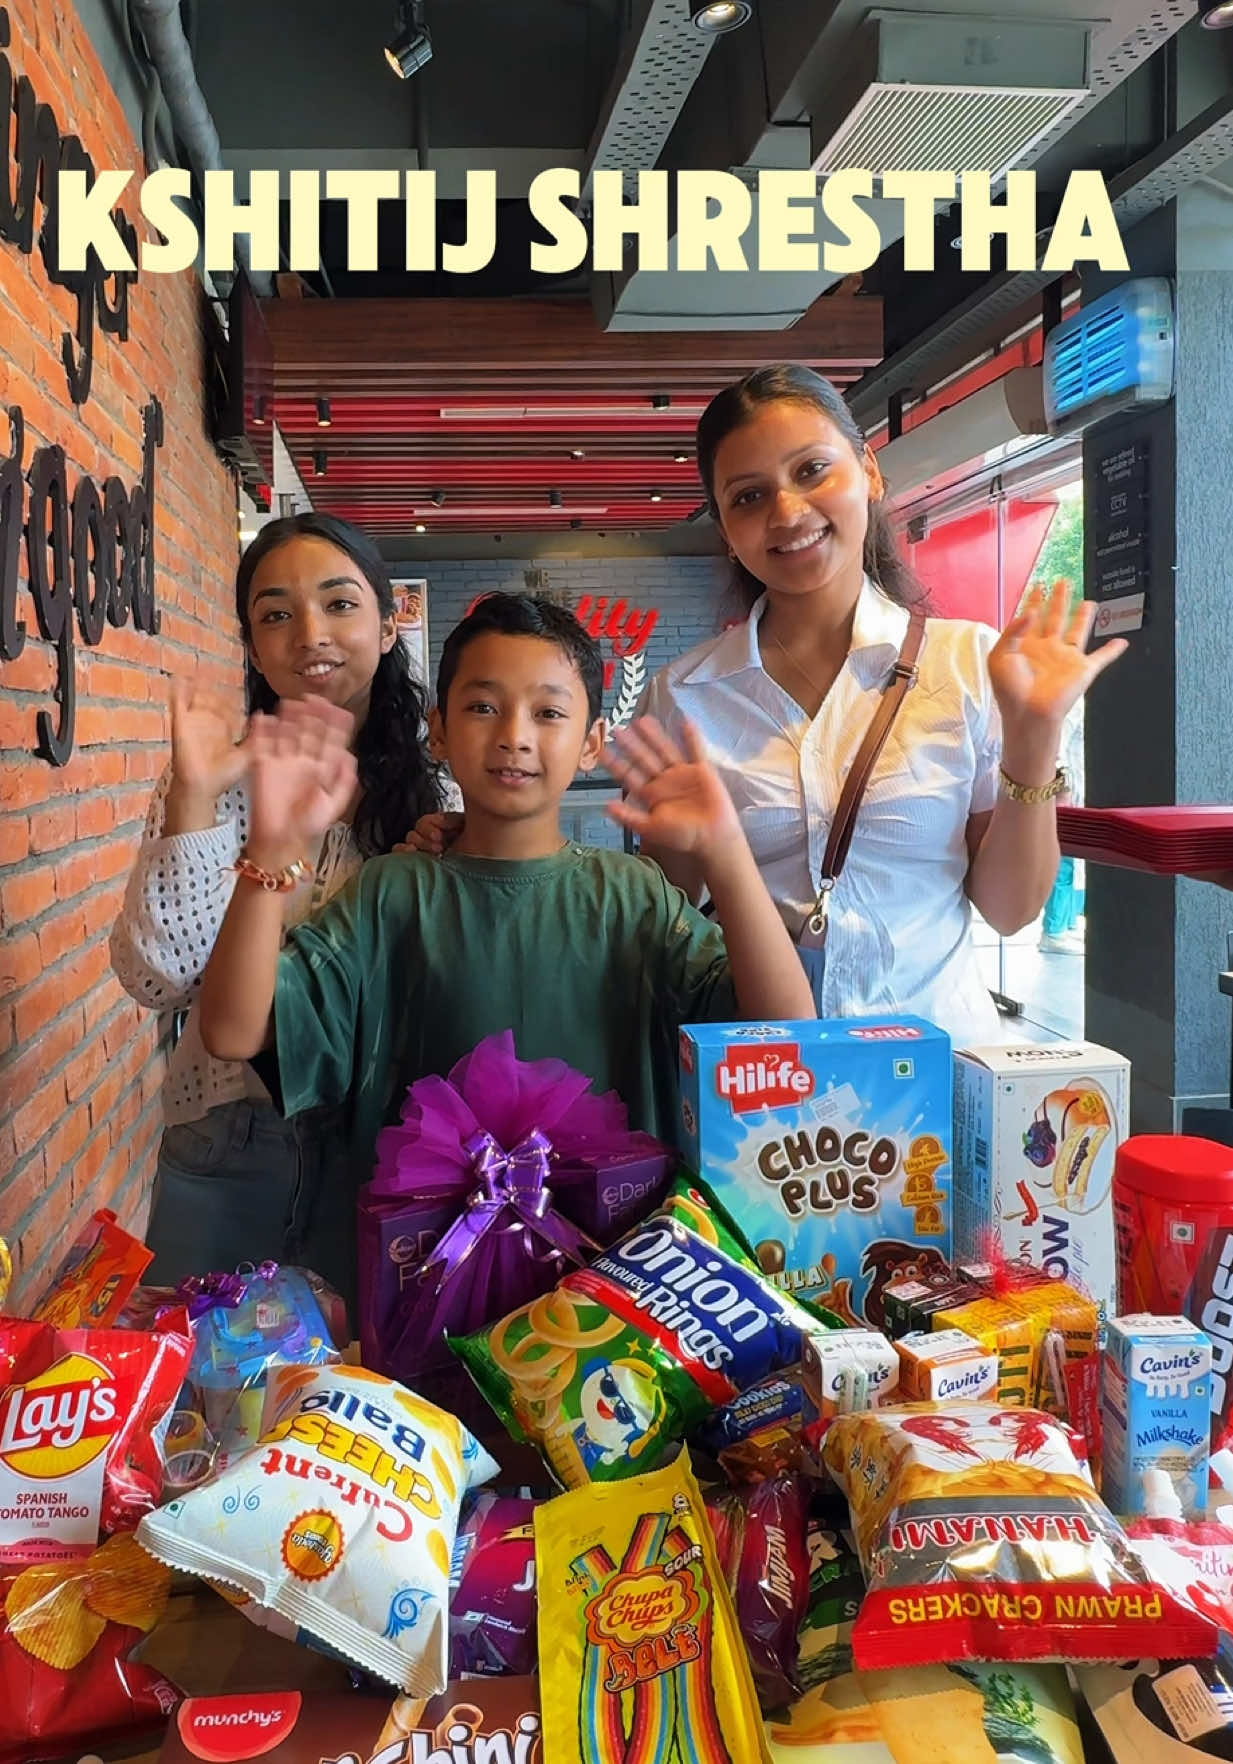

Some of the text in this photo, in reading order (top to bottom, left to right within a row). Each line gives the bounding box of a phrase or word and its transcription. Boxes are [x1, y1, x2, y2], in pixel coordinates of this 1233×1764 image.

[28, 394, 163, 767] good
[719, 1058, 811, 1095] Hilife
[757, 1126, 898, 1181] CHOCO
[780, 1168, 878, 1215] PLUS
[618, 1229, 768, 1343] Onion
[634, 1285, 735, 1371] Rings
[1140, 1351, 1200, 1375] Cavin's
[937, 1365, 990, 1397] Cavin's
[1, 1376, 118, 1451] Lay's
[300, 1389, 426, 1463] Balls
[1150, 1409, 1188, 1419] VANILLA
[1136, 1424, 1204, 1447] Milkshake
[16, 1493, 68, 1505] SPANISH
[260, 1447, 414, 1543] Current
[0, 1506, 89, 1519] OMATO TANGO
[892, 1514, 1098, 1552] HANAMI
[664, 1544, 703, 1577] SOUR
[608, 1584, 675, 1612] Chupa
[888, 1592, 1042, 1624] CRACKERS
[1056, 1593, 1162, 1618] PRAWN
[606, 1600, 675, 1631] Chups
[194, 1709, 283, 1728] munchy's
